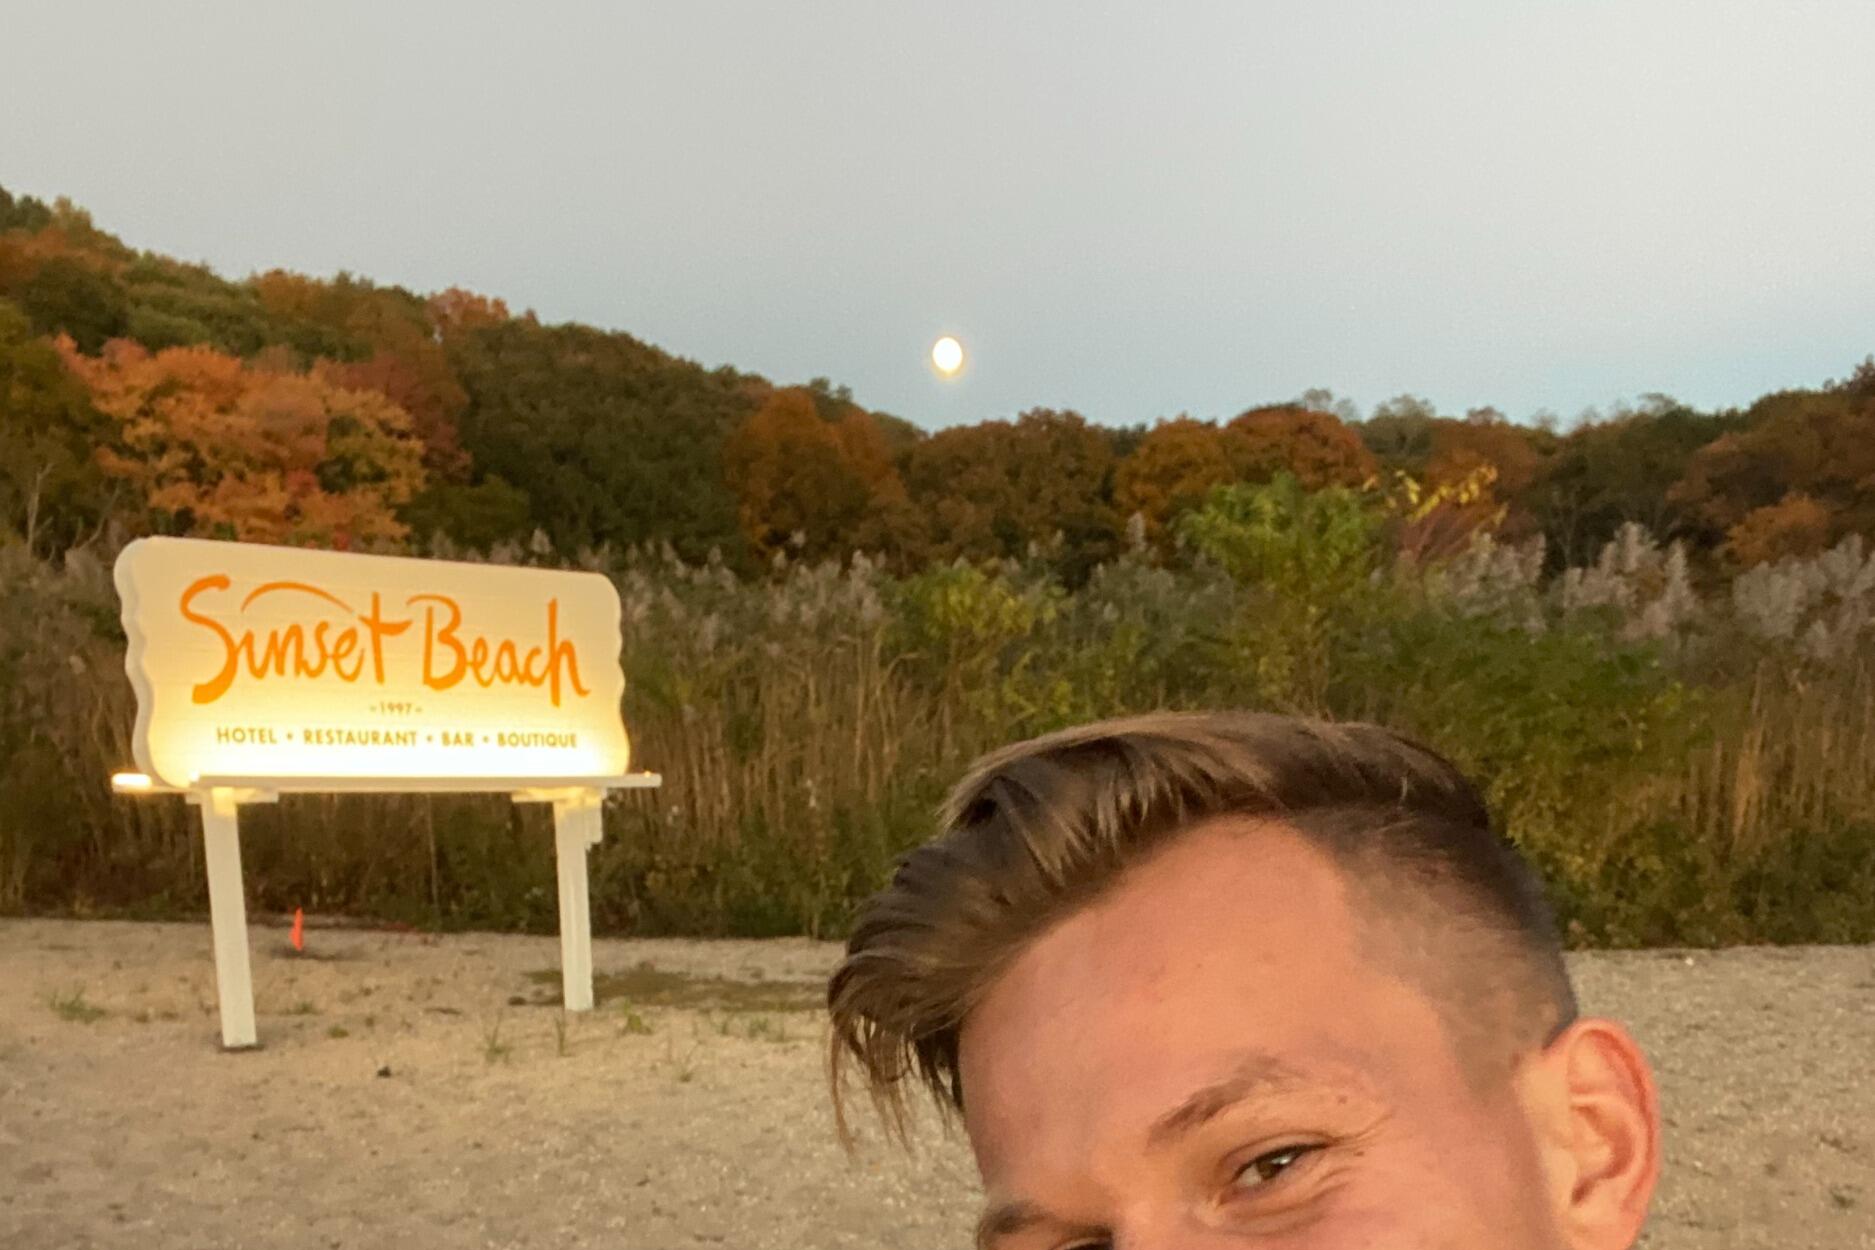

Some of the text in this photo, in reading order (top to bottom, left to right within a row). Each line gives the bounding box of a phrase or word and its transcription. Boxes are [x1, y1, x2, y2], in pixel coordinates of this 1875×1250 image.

[180, 574, 591, 708] Sunset Beach
[216, 726, 578, 749] HOTEL RESTAURANT BAR BOUTIQUE
